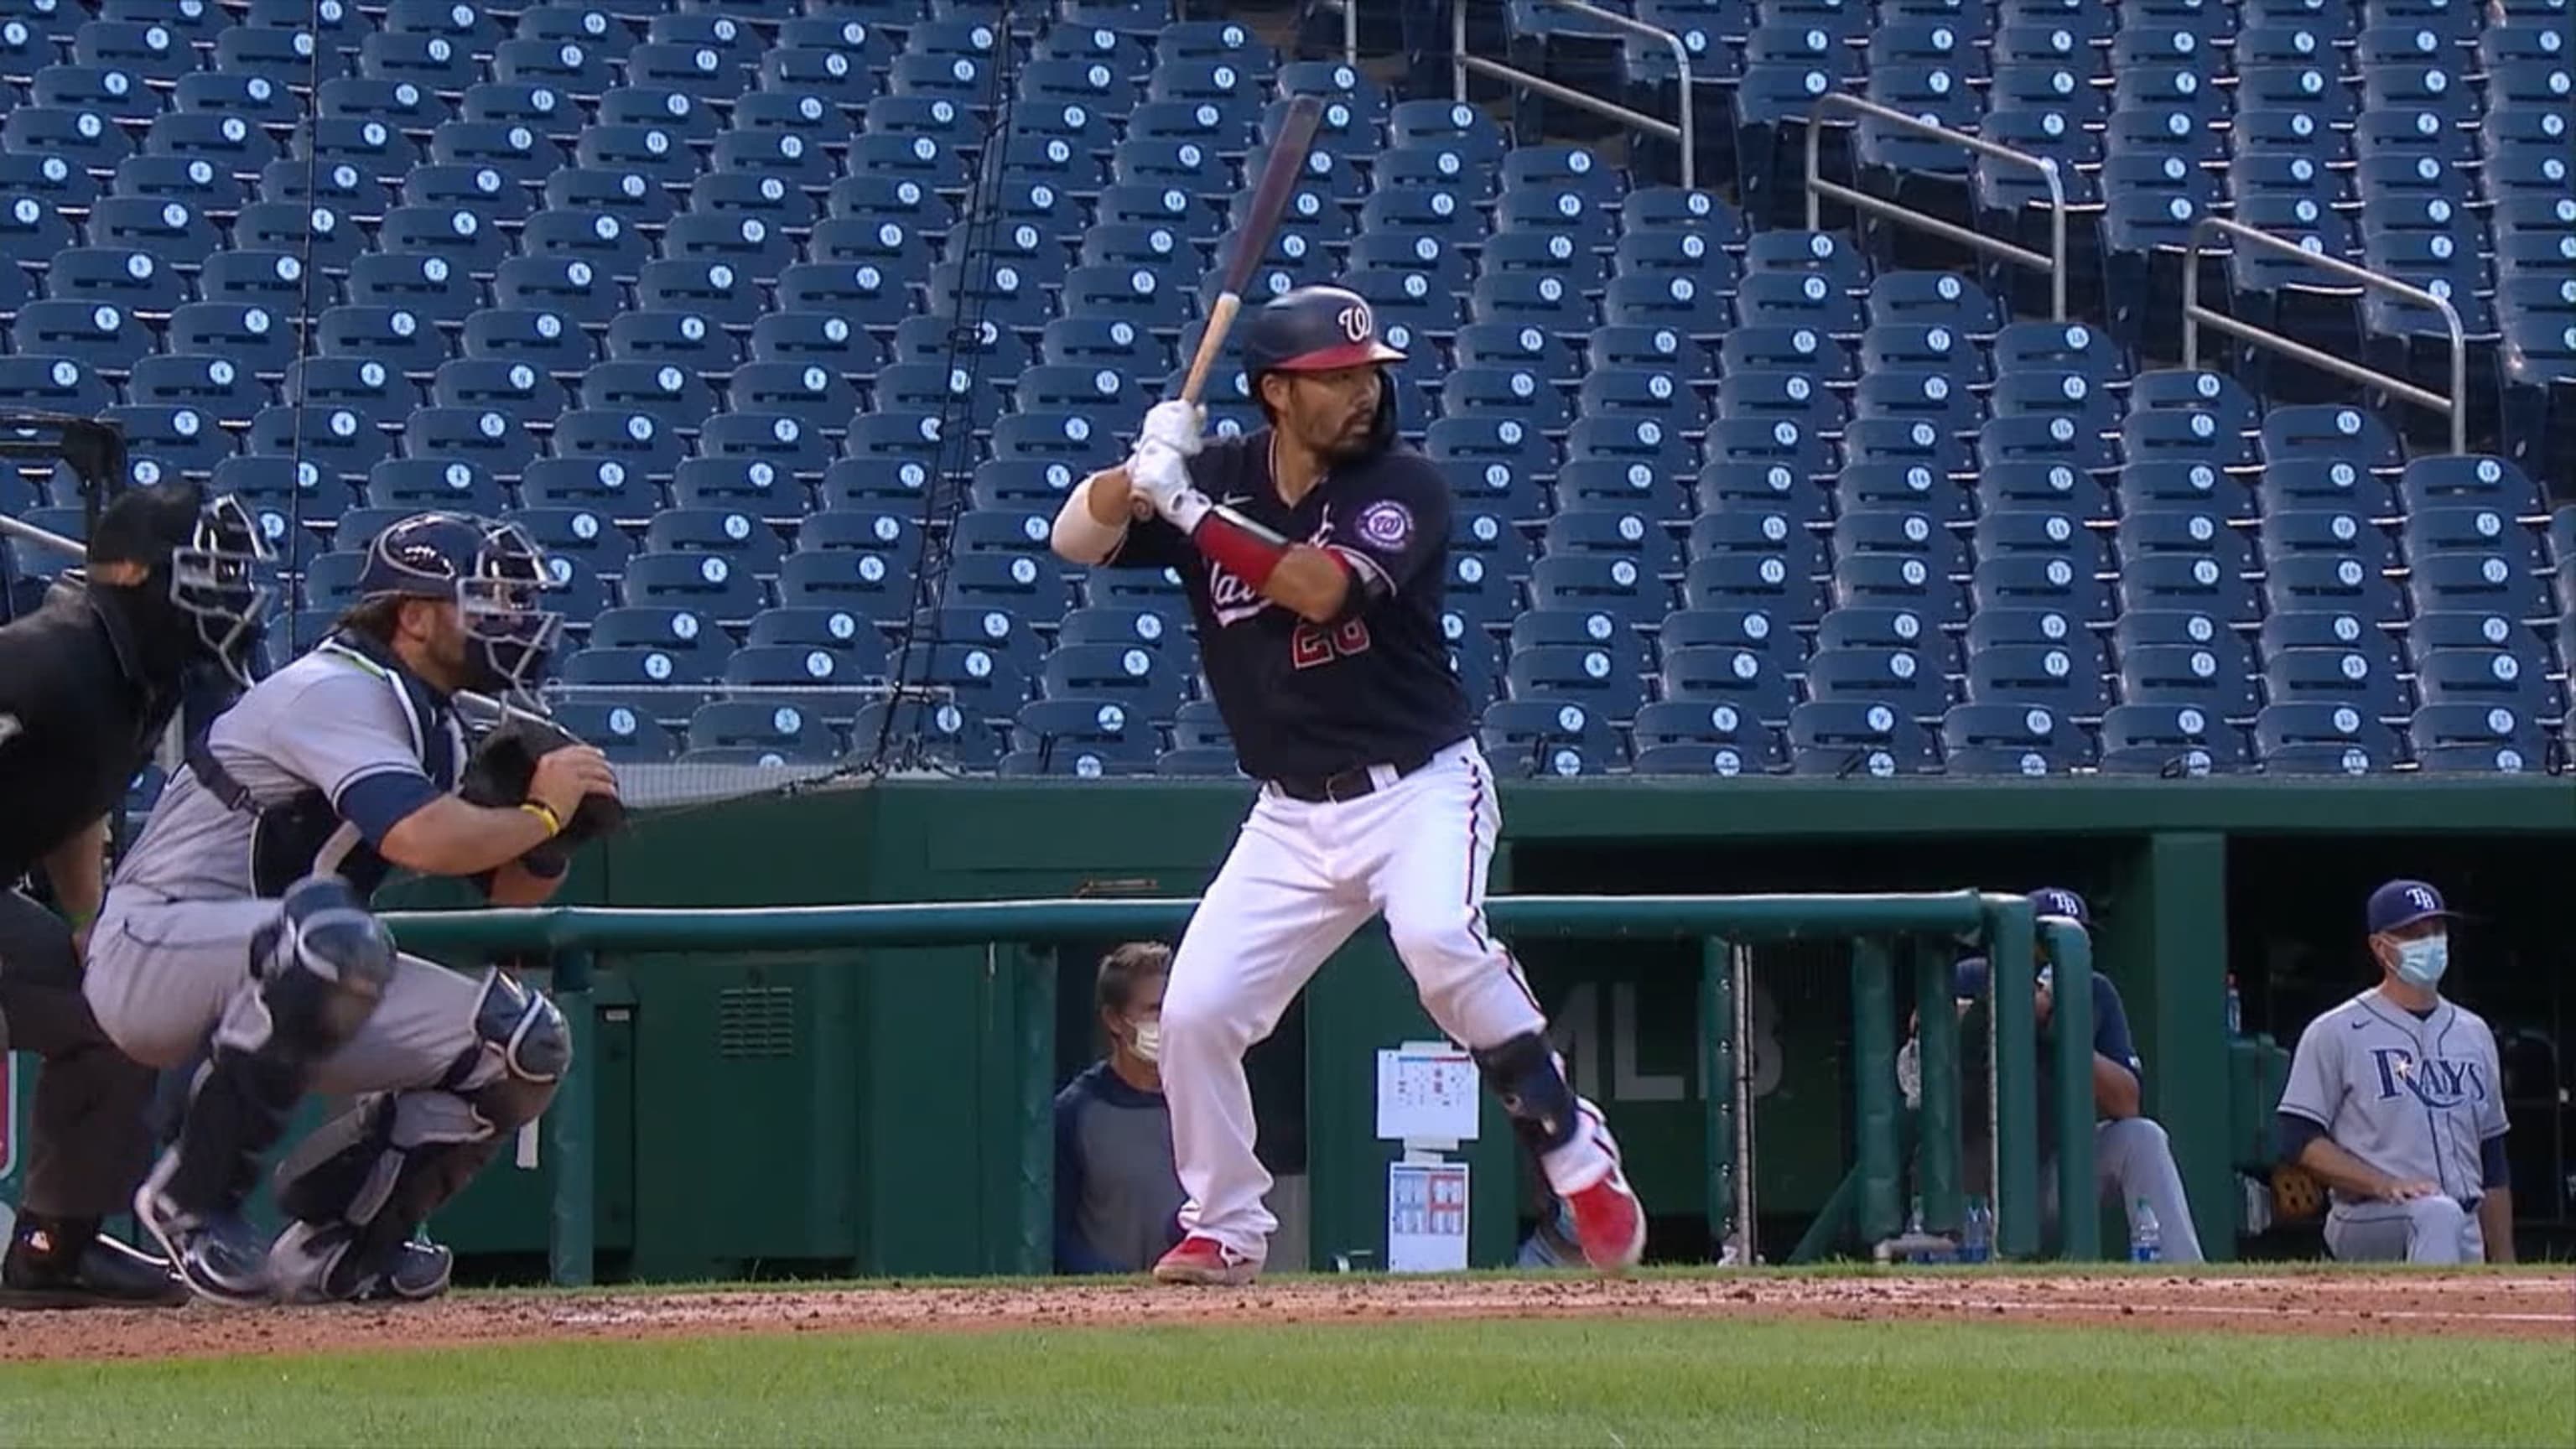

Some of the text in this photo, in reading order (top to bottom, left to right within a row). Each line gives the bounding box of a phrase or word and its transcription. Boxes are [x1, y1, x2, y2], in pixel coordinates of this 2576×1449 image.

[1337, 307, 1372, 341] W
[2049, 891, 2078, 914] TB
[2406, 887, 2435, 910] TB
